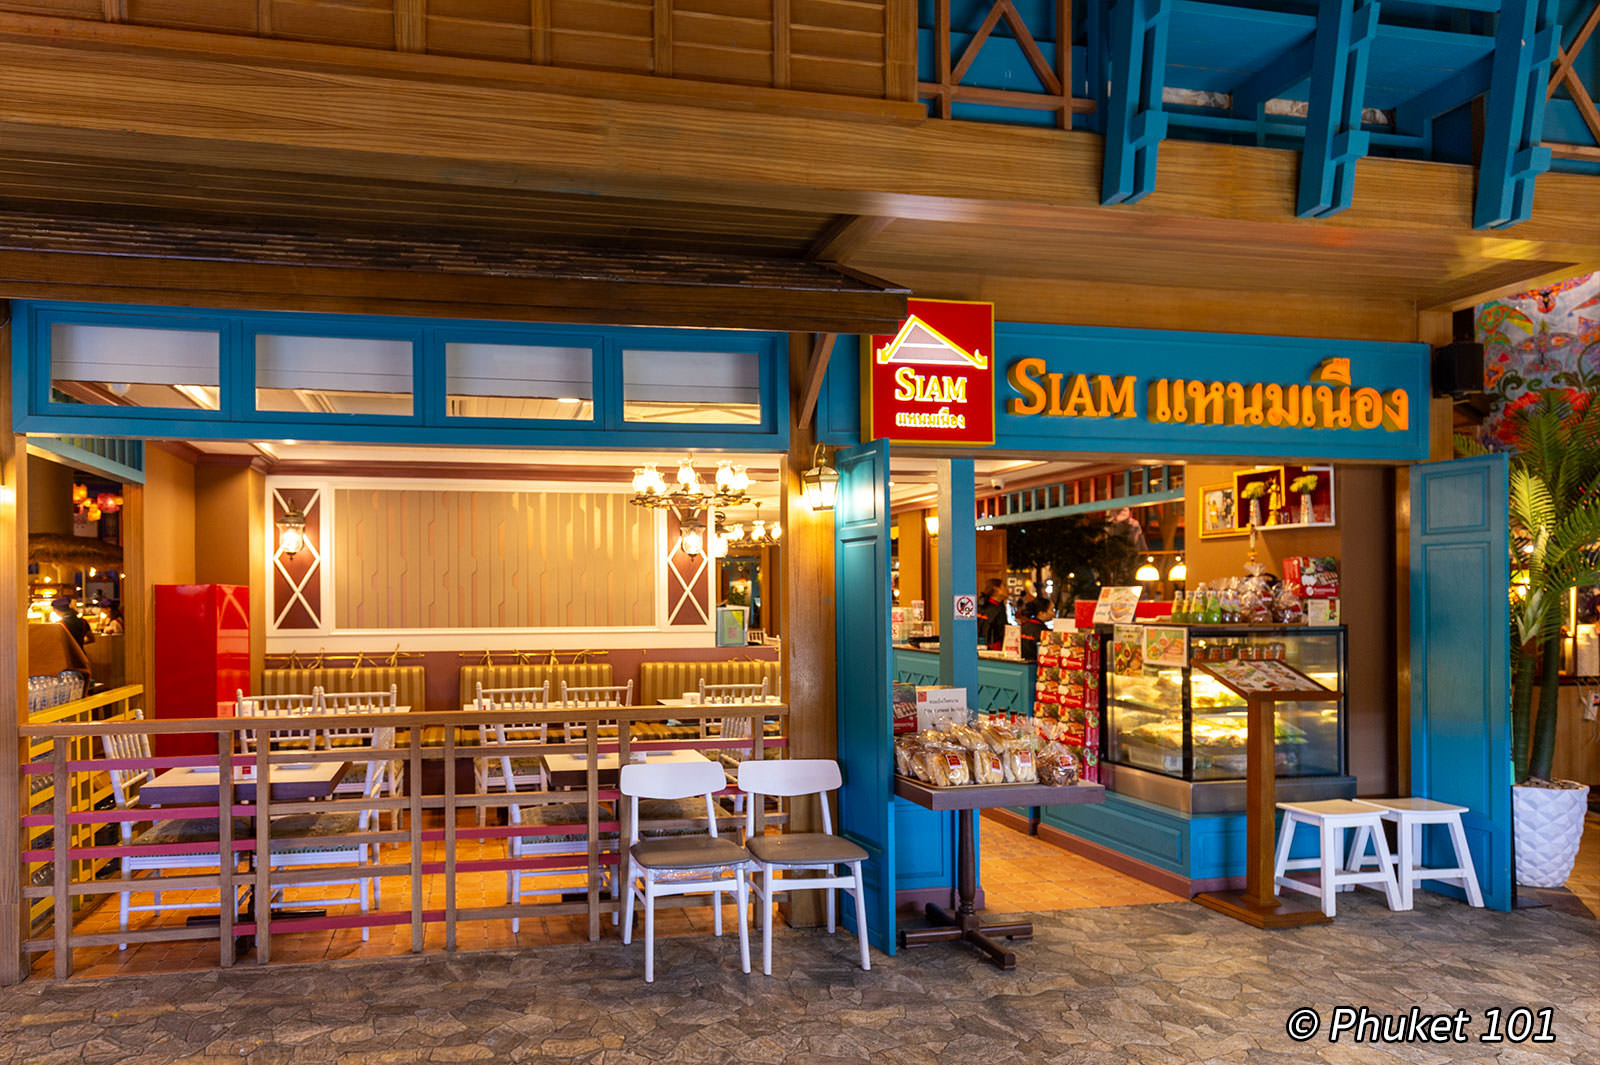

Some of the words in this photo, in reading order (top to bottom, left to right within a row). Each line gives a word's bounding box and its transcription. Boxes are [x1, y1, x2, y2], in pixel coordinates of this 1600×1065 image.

[895, 366, 967, 403] SIAM
[1012, 357, 1138, 419] SIAM
[1152, 357, 1409, 431] แหนมเนือง
